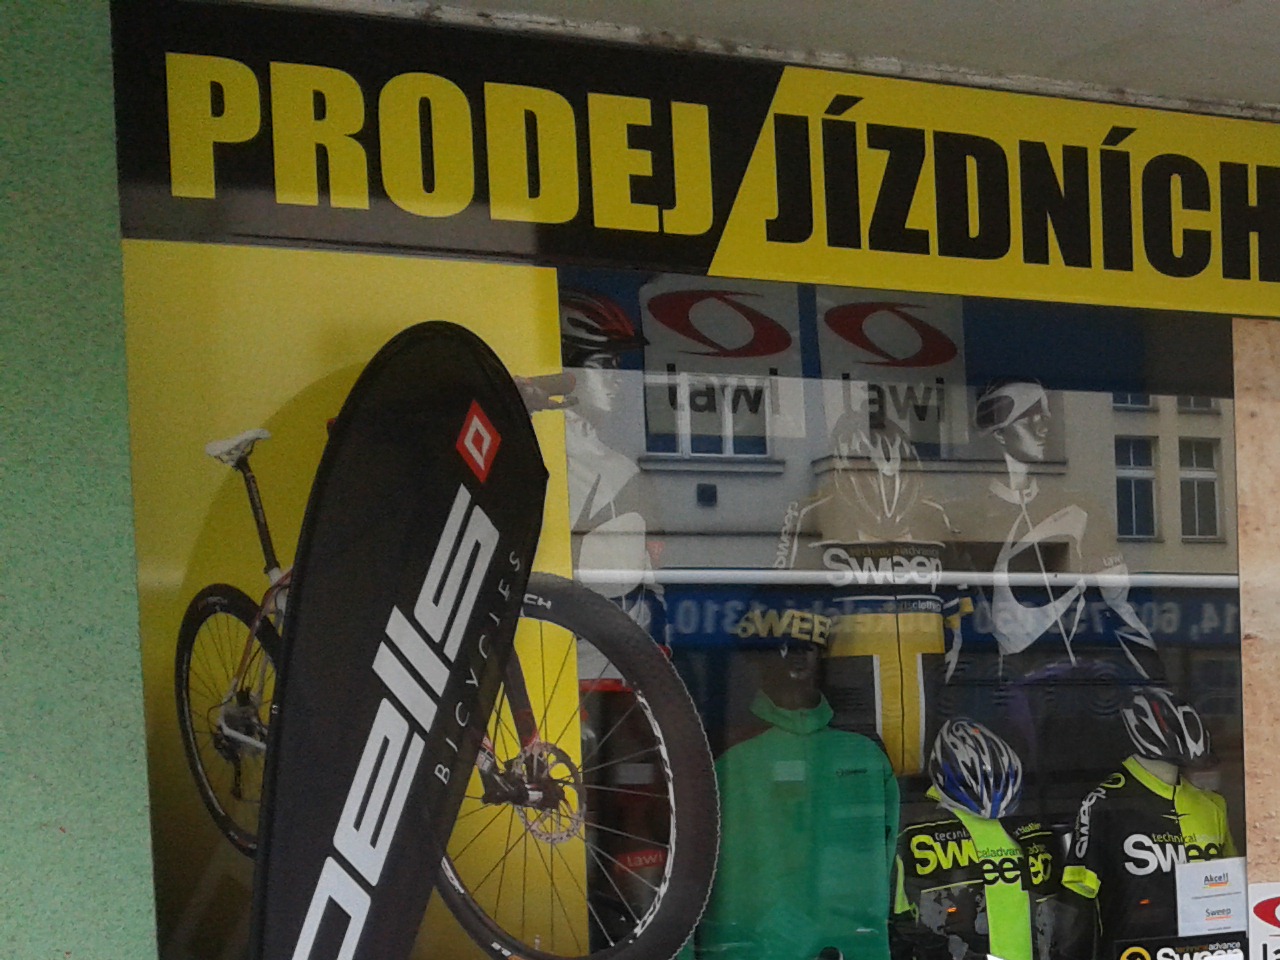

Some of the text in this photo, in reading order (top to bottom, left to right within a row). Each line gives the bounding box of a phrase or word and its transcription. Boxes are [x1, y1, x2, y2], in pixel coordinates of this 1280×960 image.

[165, 52, 715, 236] PRODEJ
[434, 550, 521, 786] BICYCLES
[1123, 833, 1225, 876] Swee
